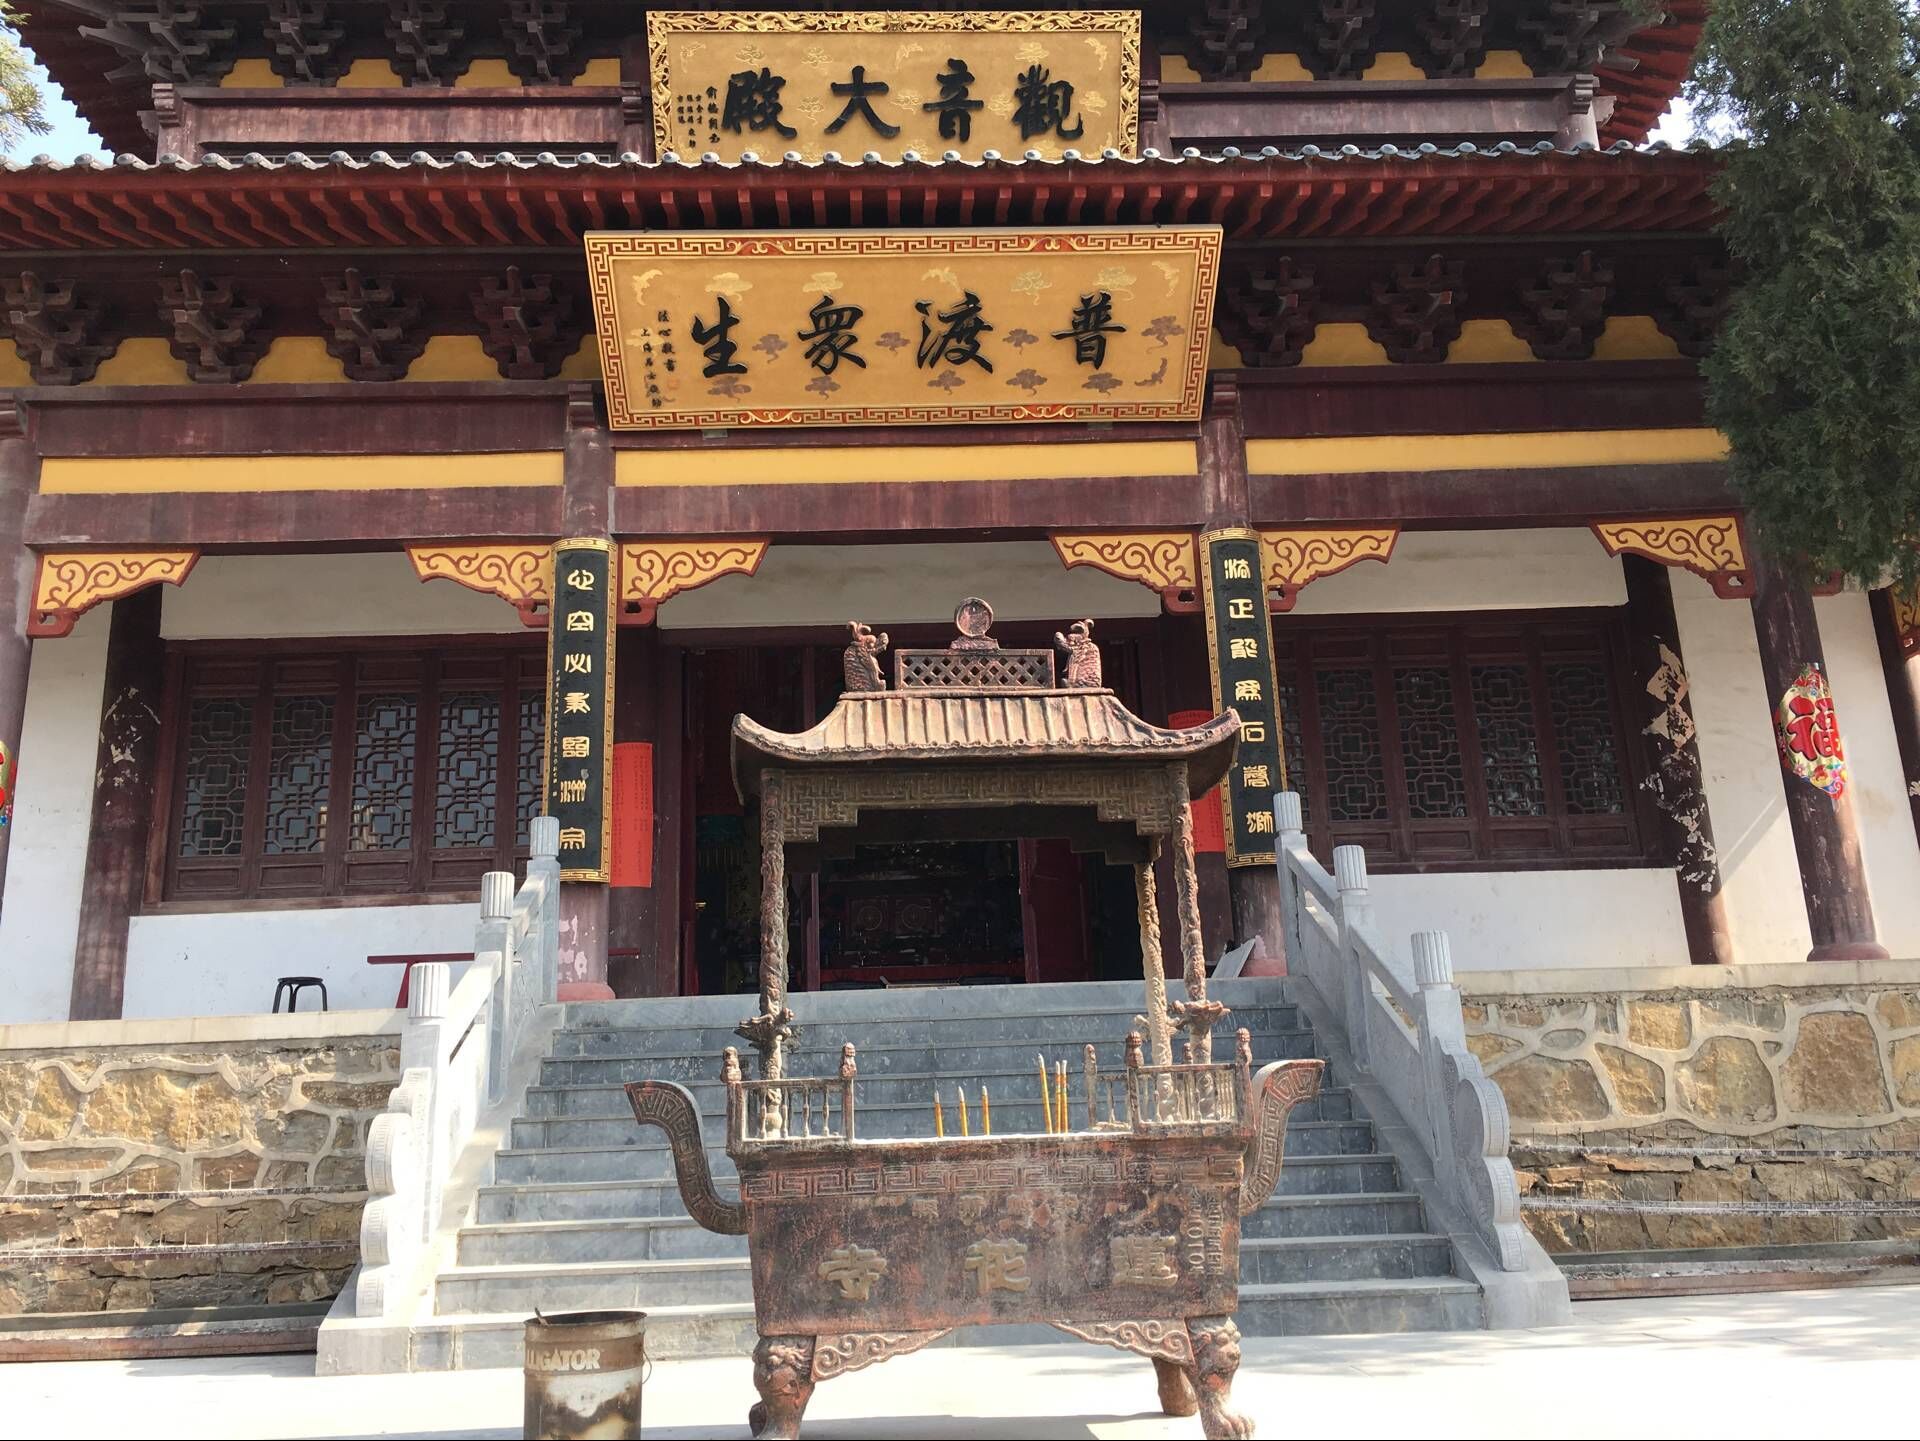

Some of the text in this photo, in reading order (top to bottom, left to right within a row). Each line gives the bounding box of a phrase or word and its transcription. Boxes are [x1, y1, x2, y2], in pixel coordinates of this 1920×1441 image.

[718, 58, 1084, 143] 觀音大殿
[1786, 696, 1844, 761] 福
